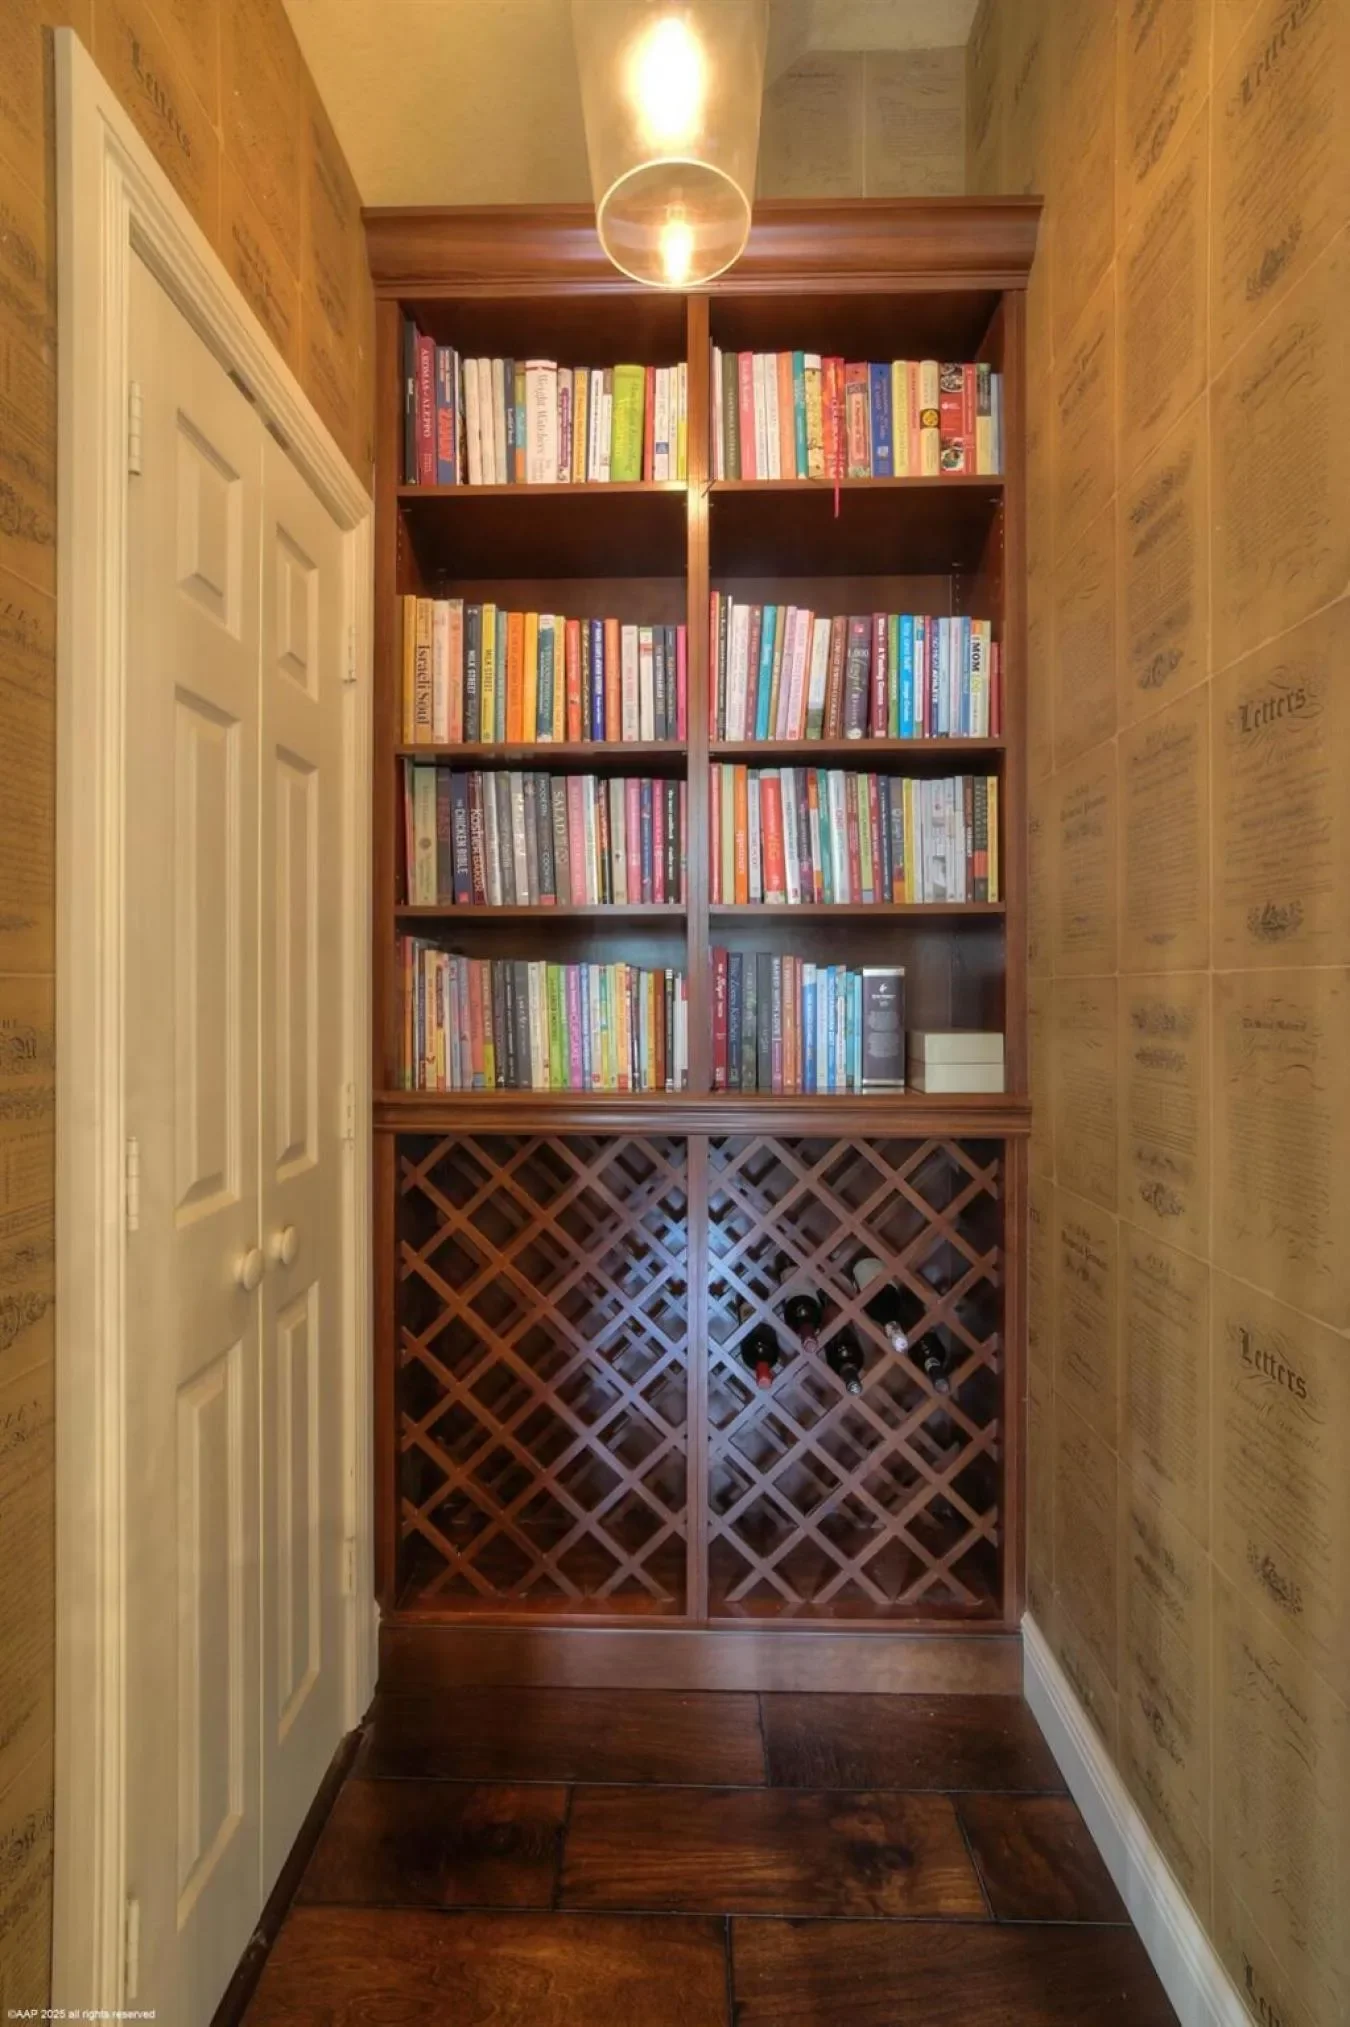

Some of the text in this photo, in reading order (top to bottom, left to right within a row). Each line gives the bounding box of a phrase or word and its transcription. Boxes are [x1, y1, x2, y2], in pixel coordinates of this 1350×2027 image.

[971, 642, 982, 672] MOM
[416, 645, 432, 725] Israeli Soul
[1238, 688, 1306, 733] Letters
[455, 808, 467, 847] CHICKEN
[553, 791, 566, 834] SALAD
[457, 848, 468, 876] BIBLE
[1239, 1327, 1307, 1399] Letters
